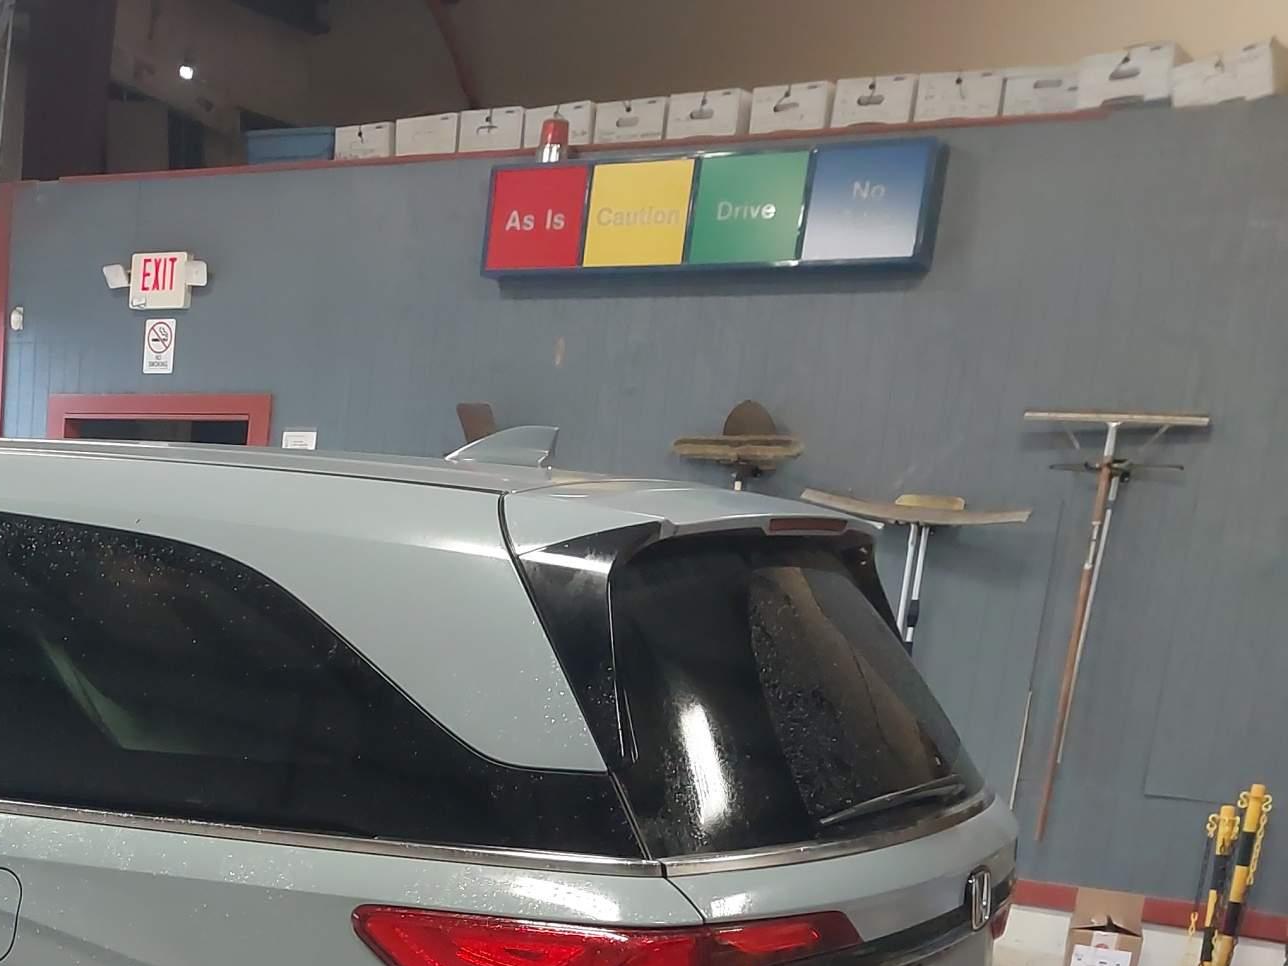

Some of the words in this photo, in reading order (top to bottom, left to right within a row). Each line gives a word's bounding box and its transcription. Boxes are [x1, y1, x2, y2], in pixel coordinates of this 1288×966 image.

[504, 209, 535, 232] As
[545, 208, 566, 231] Is
[596, 205, 681, 227] Caution
[716, 200, 777, 222] Drive
[141, 258, 178, 291] EXIT
